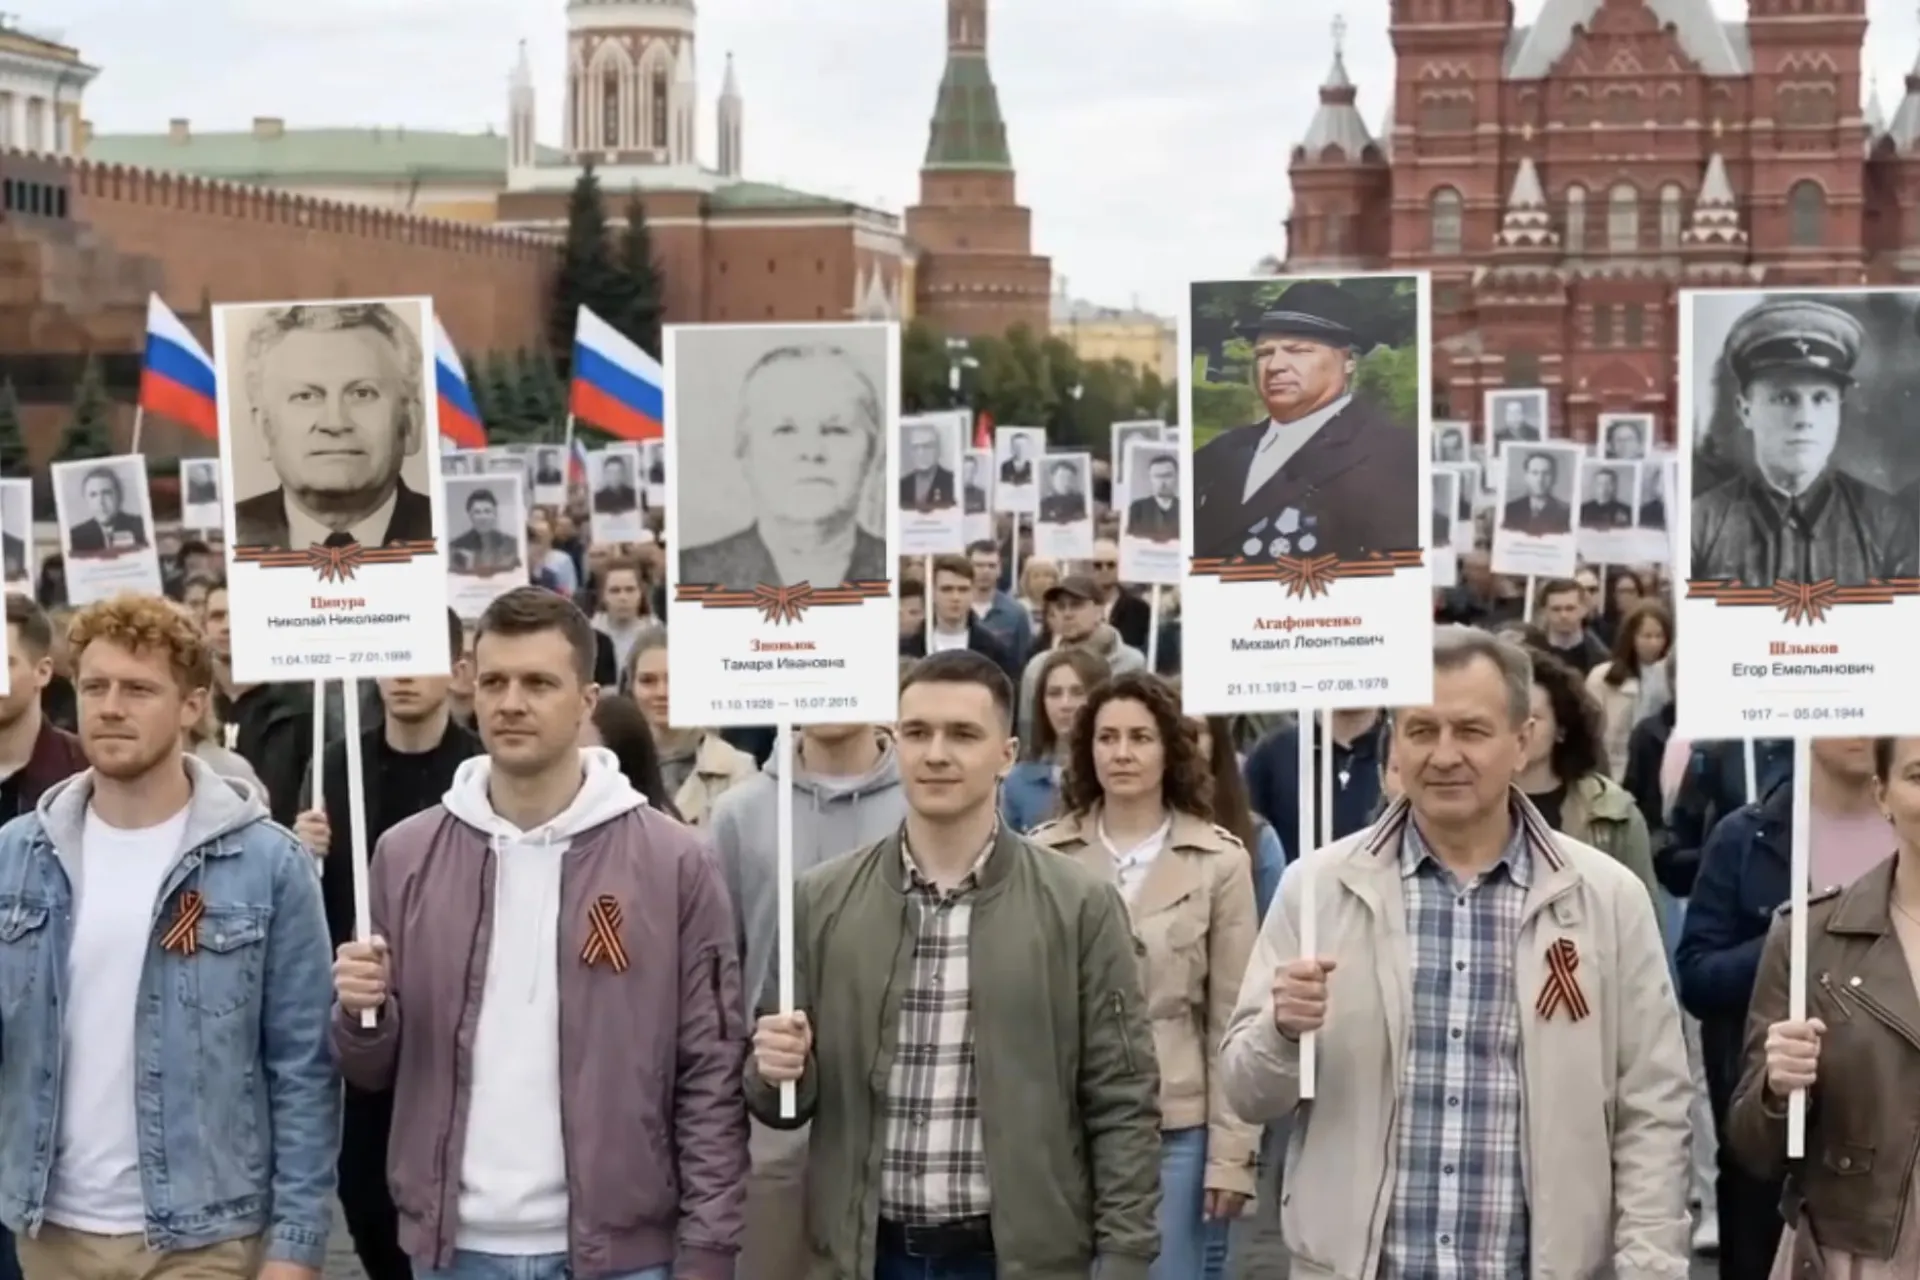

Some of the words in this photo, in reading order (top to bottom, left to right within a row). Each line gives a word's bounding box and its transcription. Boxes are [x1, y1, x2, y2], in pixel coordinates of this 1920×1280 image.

[267, 615, 326, 630] Николай
[329, 610, 412, 626] Николаевич
[1231, 638, 1290, 653] Михаил
[1294, 634, 1385, 651] Леонтьевич
[721, 658, 775, 673] Тамара
[779, 657, 846, 670] Ивановна
[1731, 662, 1768, 679] Егор
[1772, 660, 1876, 677] Емельянович
[1742, 708, 1773, 720] 1917
